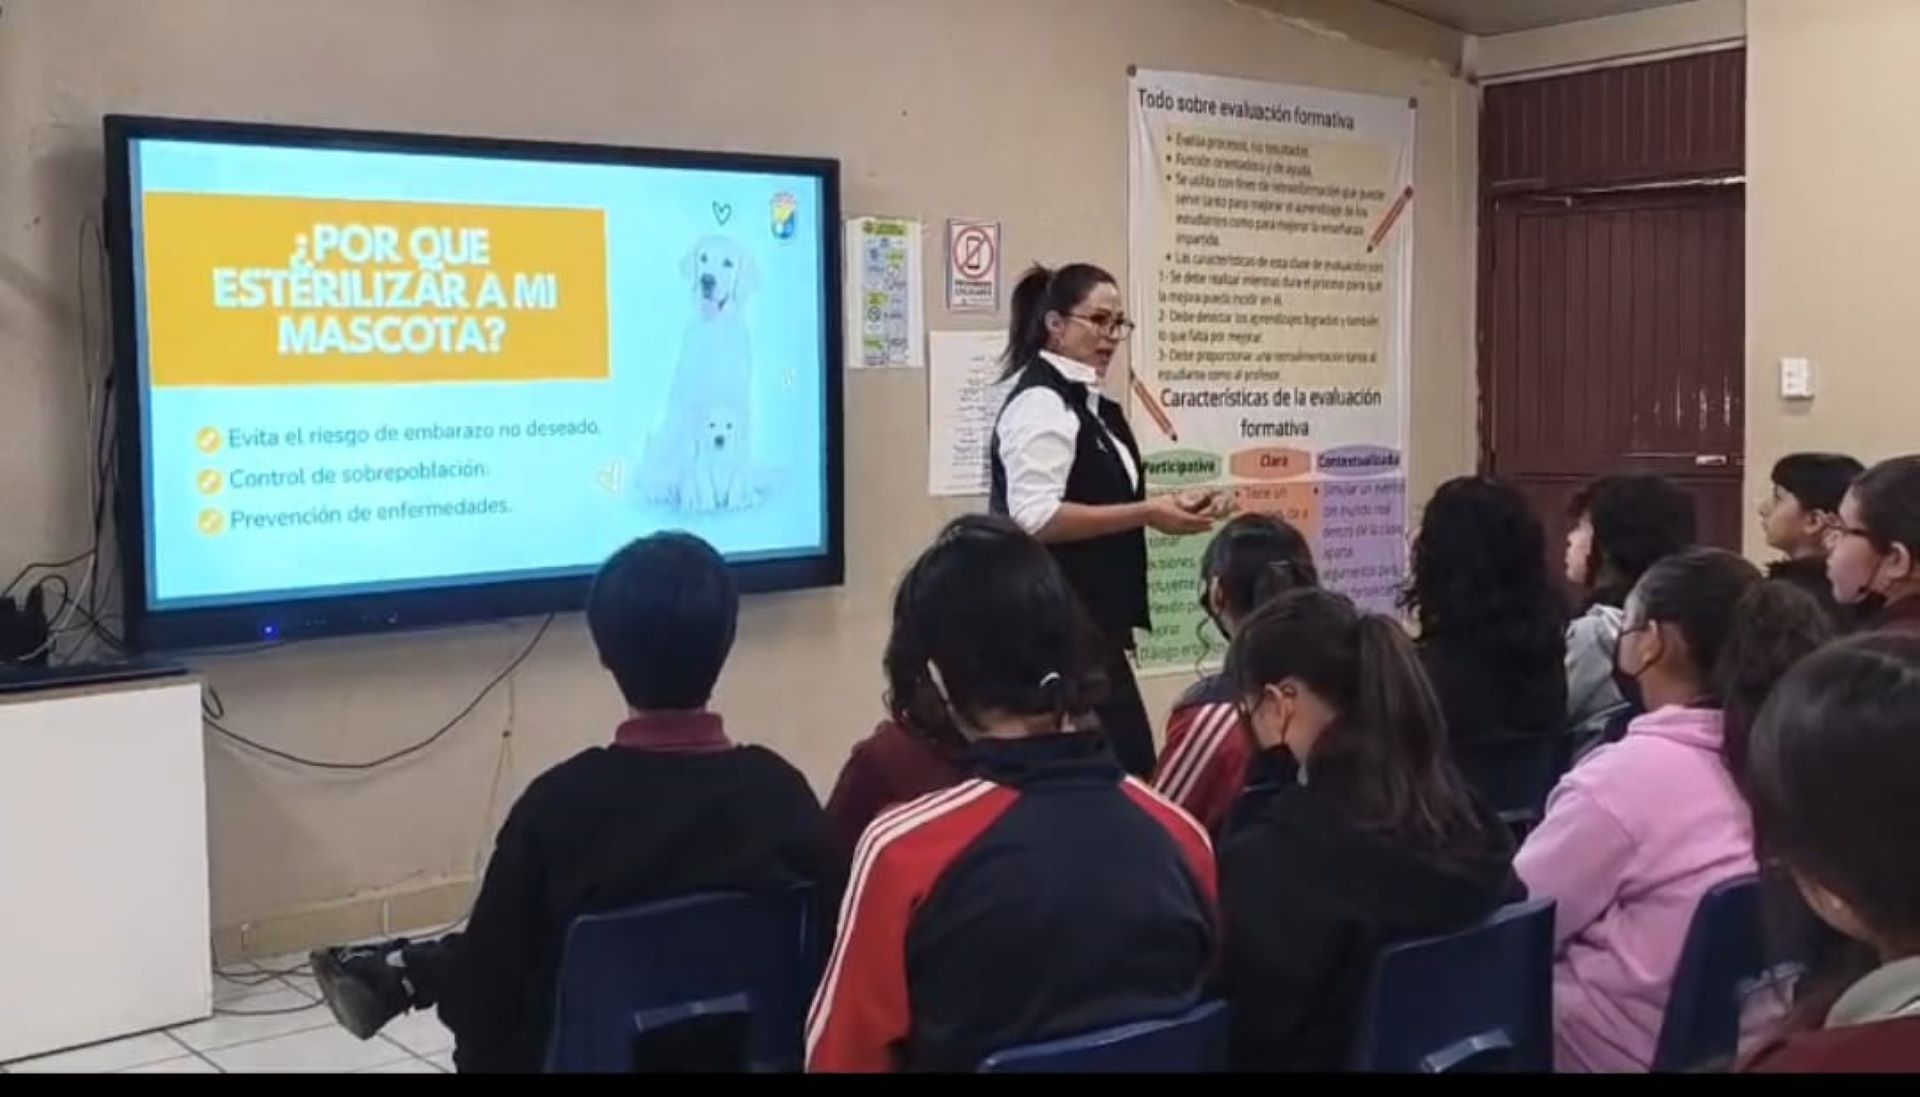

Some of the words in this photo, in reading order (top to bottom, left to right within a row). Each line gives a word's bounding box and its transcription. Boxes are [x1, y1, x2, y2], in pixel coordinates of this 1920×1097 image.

[1138, 88, 1174, 111] Todo
[1176, 95, 1217, 116] sobre
[1220, 100, 1292, 123] evaluación
[1294, 105, 1355, 131] formativa
[290, 222, 403, 276] ¿POR
[409, 226, 492, 272] QUE
[213, 265, 472, 311] ESTERILIZAR
[477, 270, 510, 310] A
[514, 271, 560, 311] MI
[279, 314, 507, 356] MASCOTA?
[1160, 387, 1269, 408] Características
[1271, 388, 1292, 407] de
[1293, 386, 1308, 406] la
[1309, 386, 1383, 408] evaluación
[229, 426, 280, 449] Evita
[284, 426, 304, 447] el
[308, 425, 371, 448] riesgo
[374, 423, 400, 443] de
[403, 420, 495, 441] embarazo
[499, 423, 522, 439] no
[1240, 417, 1310, 440] formativa
[229, 467, 306, 489] Control
[310, 466, 336, 485] de
[230, 505, 342, 530] Prevención
[347, 503, 373, 523] de
[376, 498, 513, 522] enfermedades.
